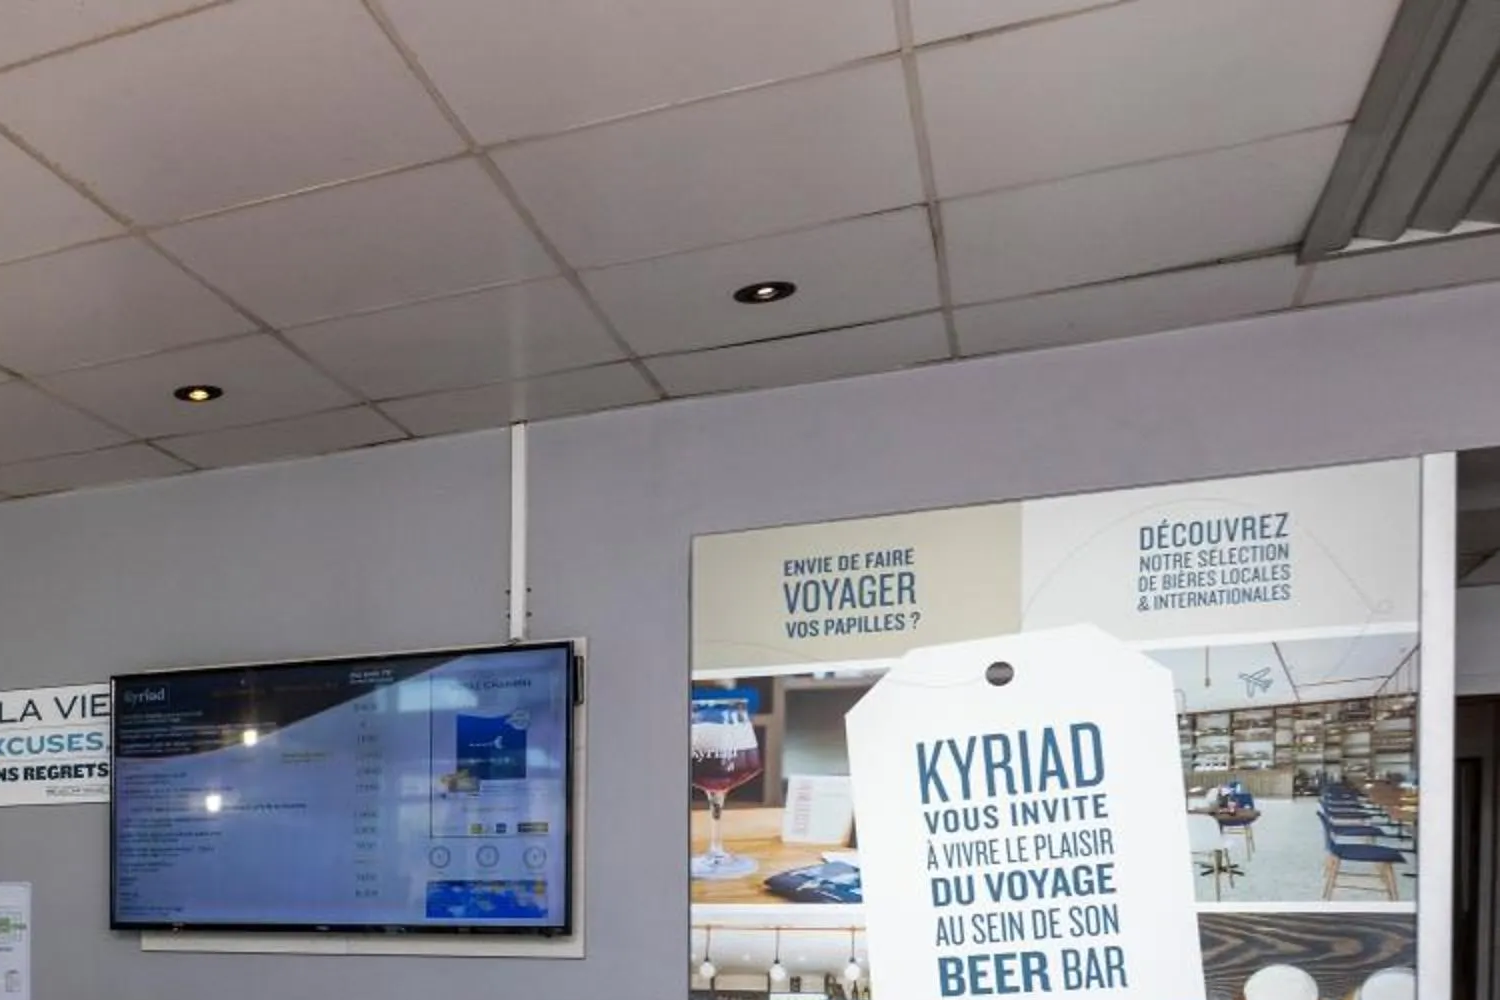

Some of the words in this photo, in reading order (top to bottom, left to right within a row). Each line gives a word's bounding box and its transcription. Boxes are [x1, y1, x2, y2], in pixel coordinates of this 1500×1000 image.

[1139, 512, 1289, 550] DÉCOUVREZ
[784, 557, 832, 576] ENVIE
[838, 553, 860, 571] DE
[865, 548, 914, 568] FAIRE
[1138, 575, 1156, 592] DE
[1162, 568, 1217, 590] BIÈRES
[1221, 564, 1291, 585] LOCALES
[1139, 552, 1193, 572] NOTRE
[784, 572, 916, 615] VOYAGER
[1137, 595, 1149, 611] &
[1153, 584, 1291, 610] INTERNATIONALES
[785, 620, 819, 638] VOS
[824, 613, 905, 636] PAPILLES
[910, 611, 921, 630] ?
[54, 693, 110, 719] VIE
[24, 762, 109, 781] REGRETS
[916, 721, 1105, 804] KYRIAD
[924, 804, 999, 834] VOUS
[1010, 793, 1108, 826] INVITE
[927, 839, 939, 871] À
[943, 839, 1000, 868] VIVRE
[1005, 835, 1029, 863] LE
[1034, 828, 1114, 861] PLAISIR
[931, 875, 974, 906] DU
[984, 863, 1117, 903] VOYAGE
[936, 915, 965, 946] AU
[971, 911, 1025, 944] SEIN
[1032, 908, 1062, 939] DE
[1069, 903, 1120, 937] SON
[938, 951, 1051, 997] BEER
[1061, 946, 1128, 990] BAR
